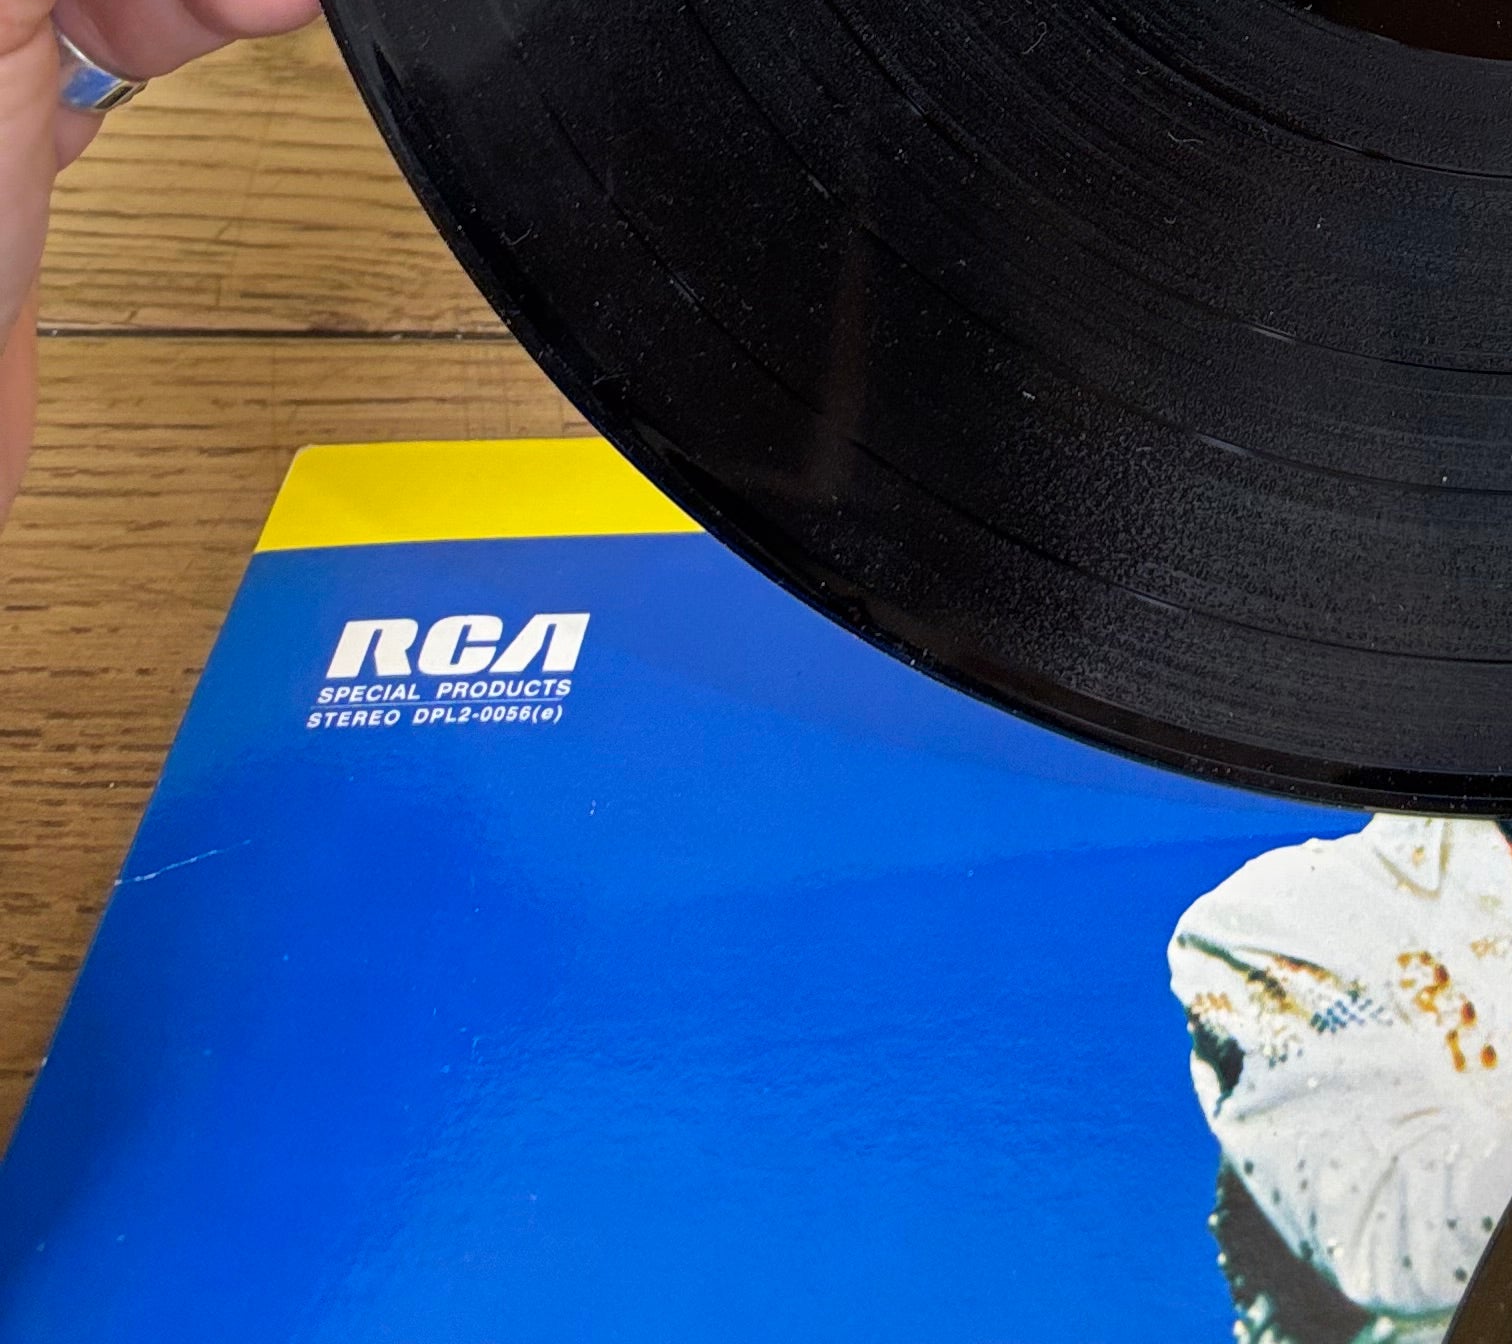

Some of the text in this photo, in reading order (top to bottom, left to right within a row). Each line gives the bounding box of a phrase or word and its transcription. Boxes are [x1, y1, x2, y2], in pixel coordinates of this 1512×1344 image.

[325, 612, 591, 679] RCA
[317, 678, 572, 705] SPECIAL PRODUCTS
[306, 704, 563, 729] STEREO DPL2-0056(e)
